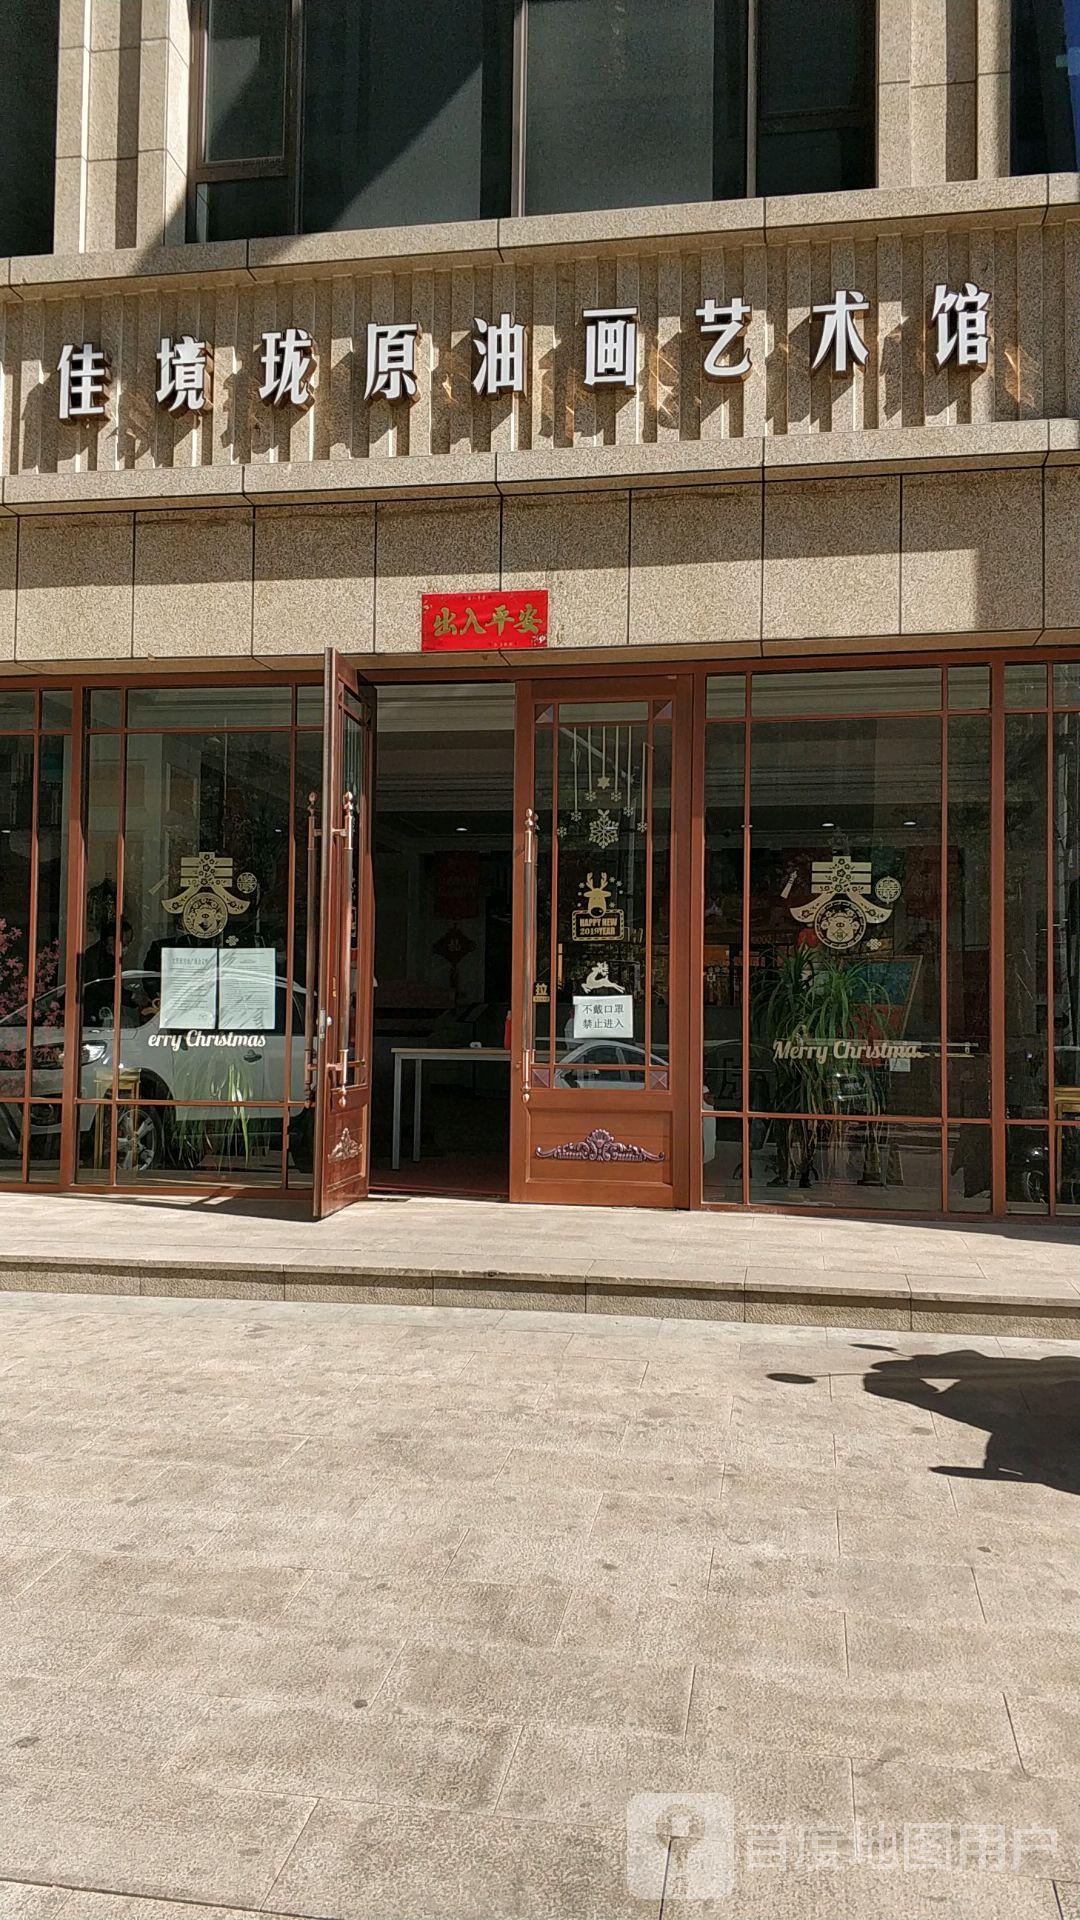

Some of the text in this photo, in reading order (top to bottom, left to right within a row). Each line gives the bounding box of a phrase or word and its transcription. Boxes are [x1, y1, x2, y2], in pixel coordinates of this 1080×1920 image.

[57, 283, 992, 419] 佳境珑原油画艺术馆
[434, 604, 542, 637] 出入平安
[580, 918, 617, 926] HAPPY NEW
[582, 1004, 624, 1014] 不戴口罩
[582, 1018, 624, 1029] 禁止进入
[186, 1030, 266, 1047] Christmas
[773, 1041, 827, 1064] Merry
